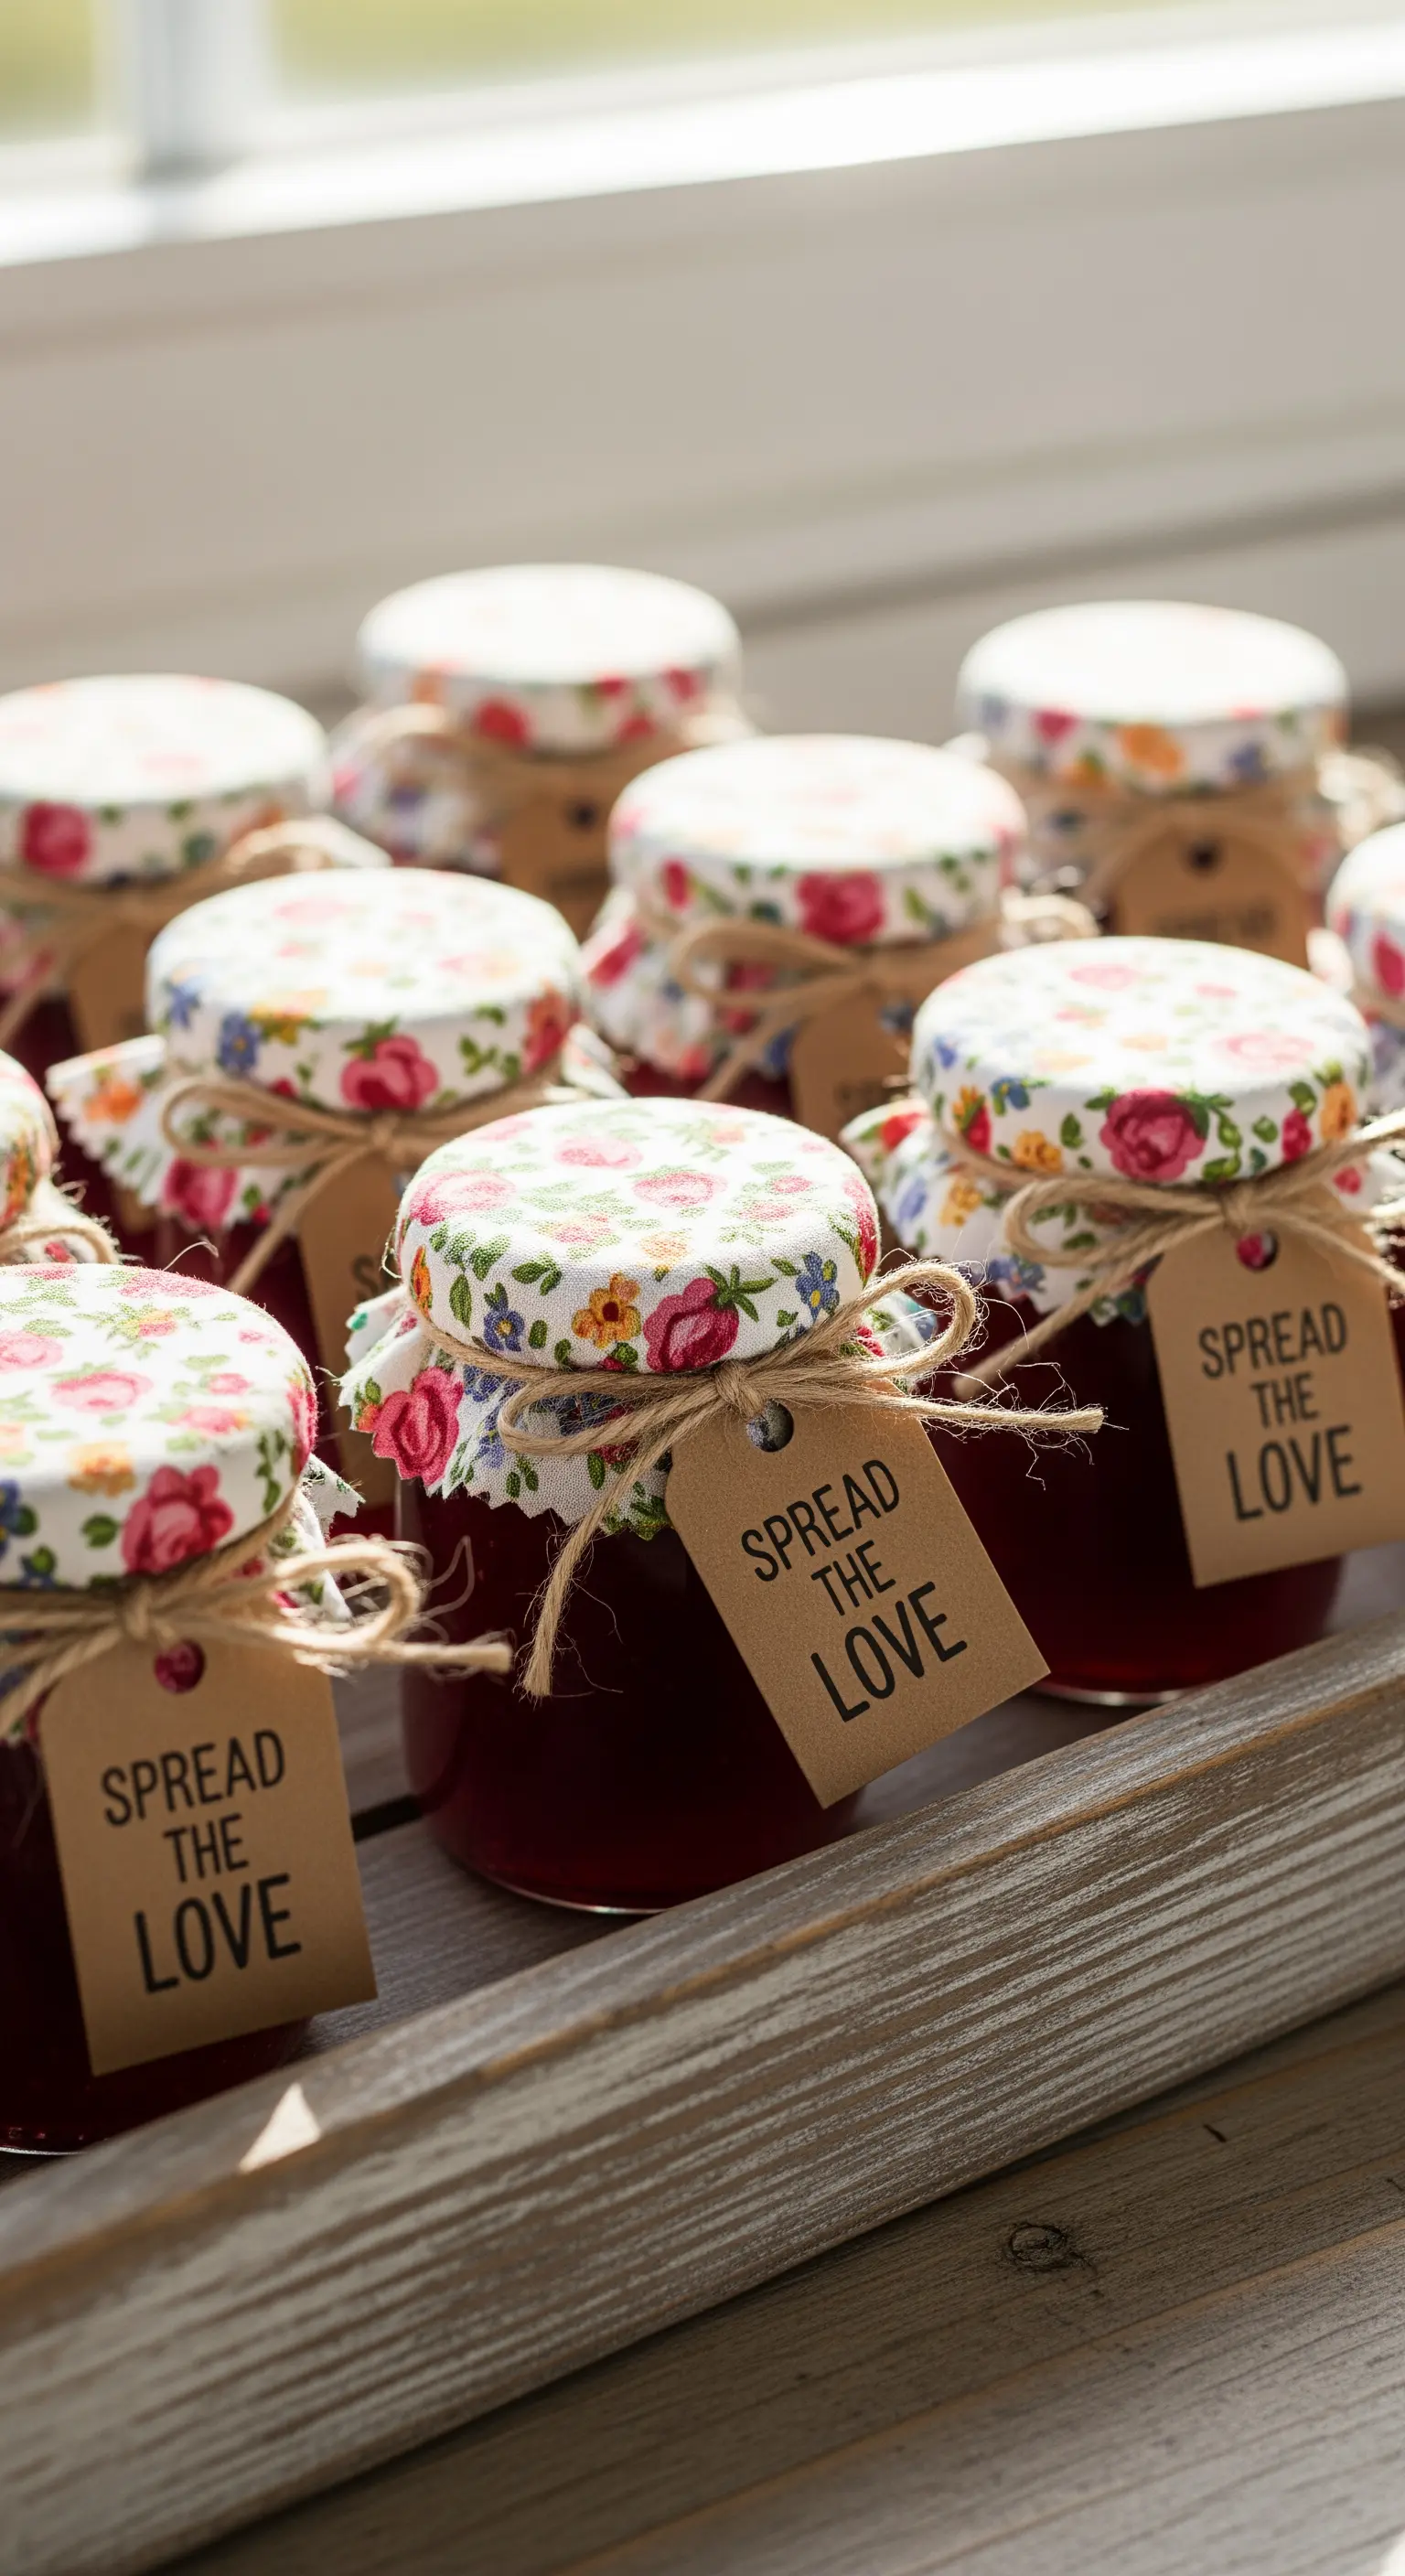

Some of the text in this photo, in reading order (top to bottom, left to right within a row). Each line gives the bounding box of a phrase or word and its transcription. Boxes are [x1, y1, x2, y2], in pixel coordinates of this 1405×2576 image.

[1198, 1303, 1347, 1379] SPREAD
[1249, 1372, 1319, 1428] THE
[741, 1460, 900, 1582] SPREAD
[1227, 1424, 1362, 1522] LOVE
[810, 1540, 896, 1615] THE
[810, 1582, 968, 1723] LOVE
[102, 1729, 284, 1826] SPREAD
[163, 1813, 250, 1883] THE
[135, 1873, 301, 1993] LOVE
